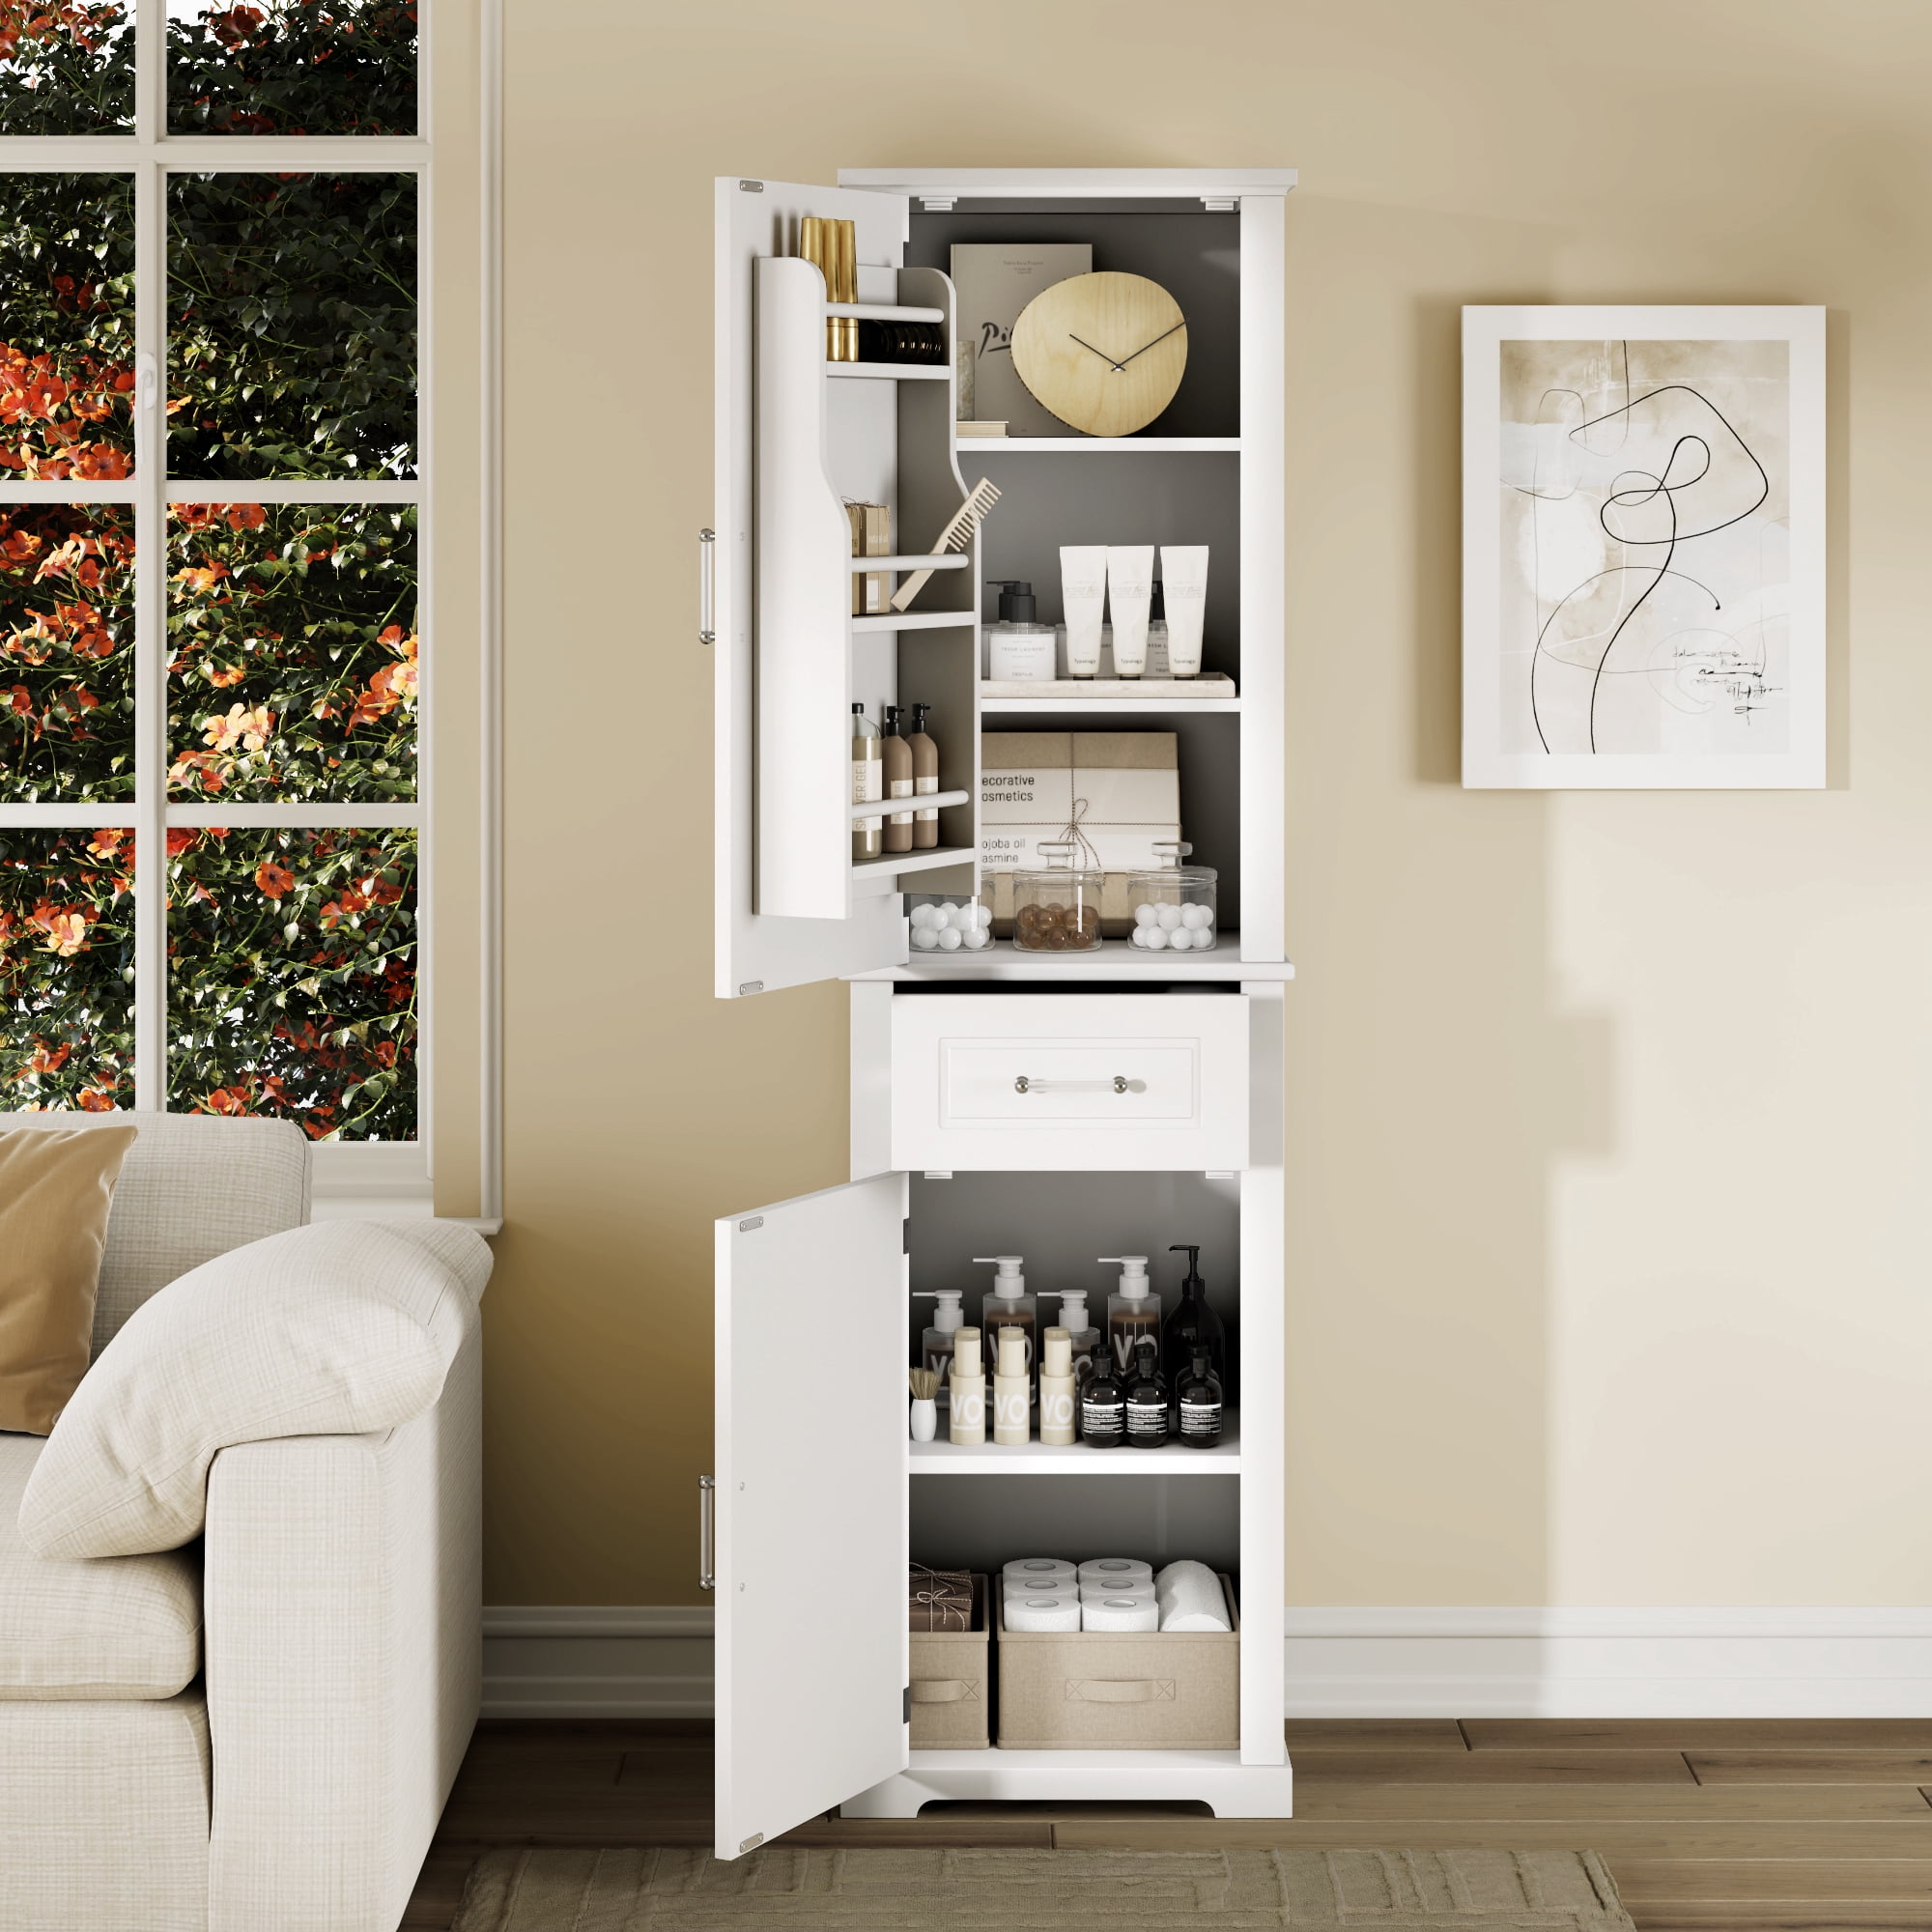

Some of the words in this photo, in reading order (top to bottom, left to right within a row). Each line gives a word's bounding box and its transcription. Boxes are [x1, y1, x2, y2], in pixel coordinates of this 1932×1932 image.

[856, 762, 867, 781] GEL
[981, 775, 1035, 786] ecorative
[981, 790, 1034, 802] osmetics
[856, 785, 867, 830] SHER
[981, 838, 1009, 851] ojoba
[1013, 838, 1026, 849] oil
[981, 853, 1019, 864] asmine
[951, 1393, 983, 1424] VO
[994, 1393, 1028, 1424] VO
[1040, 1393, 1074, 1424] VO
